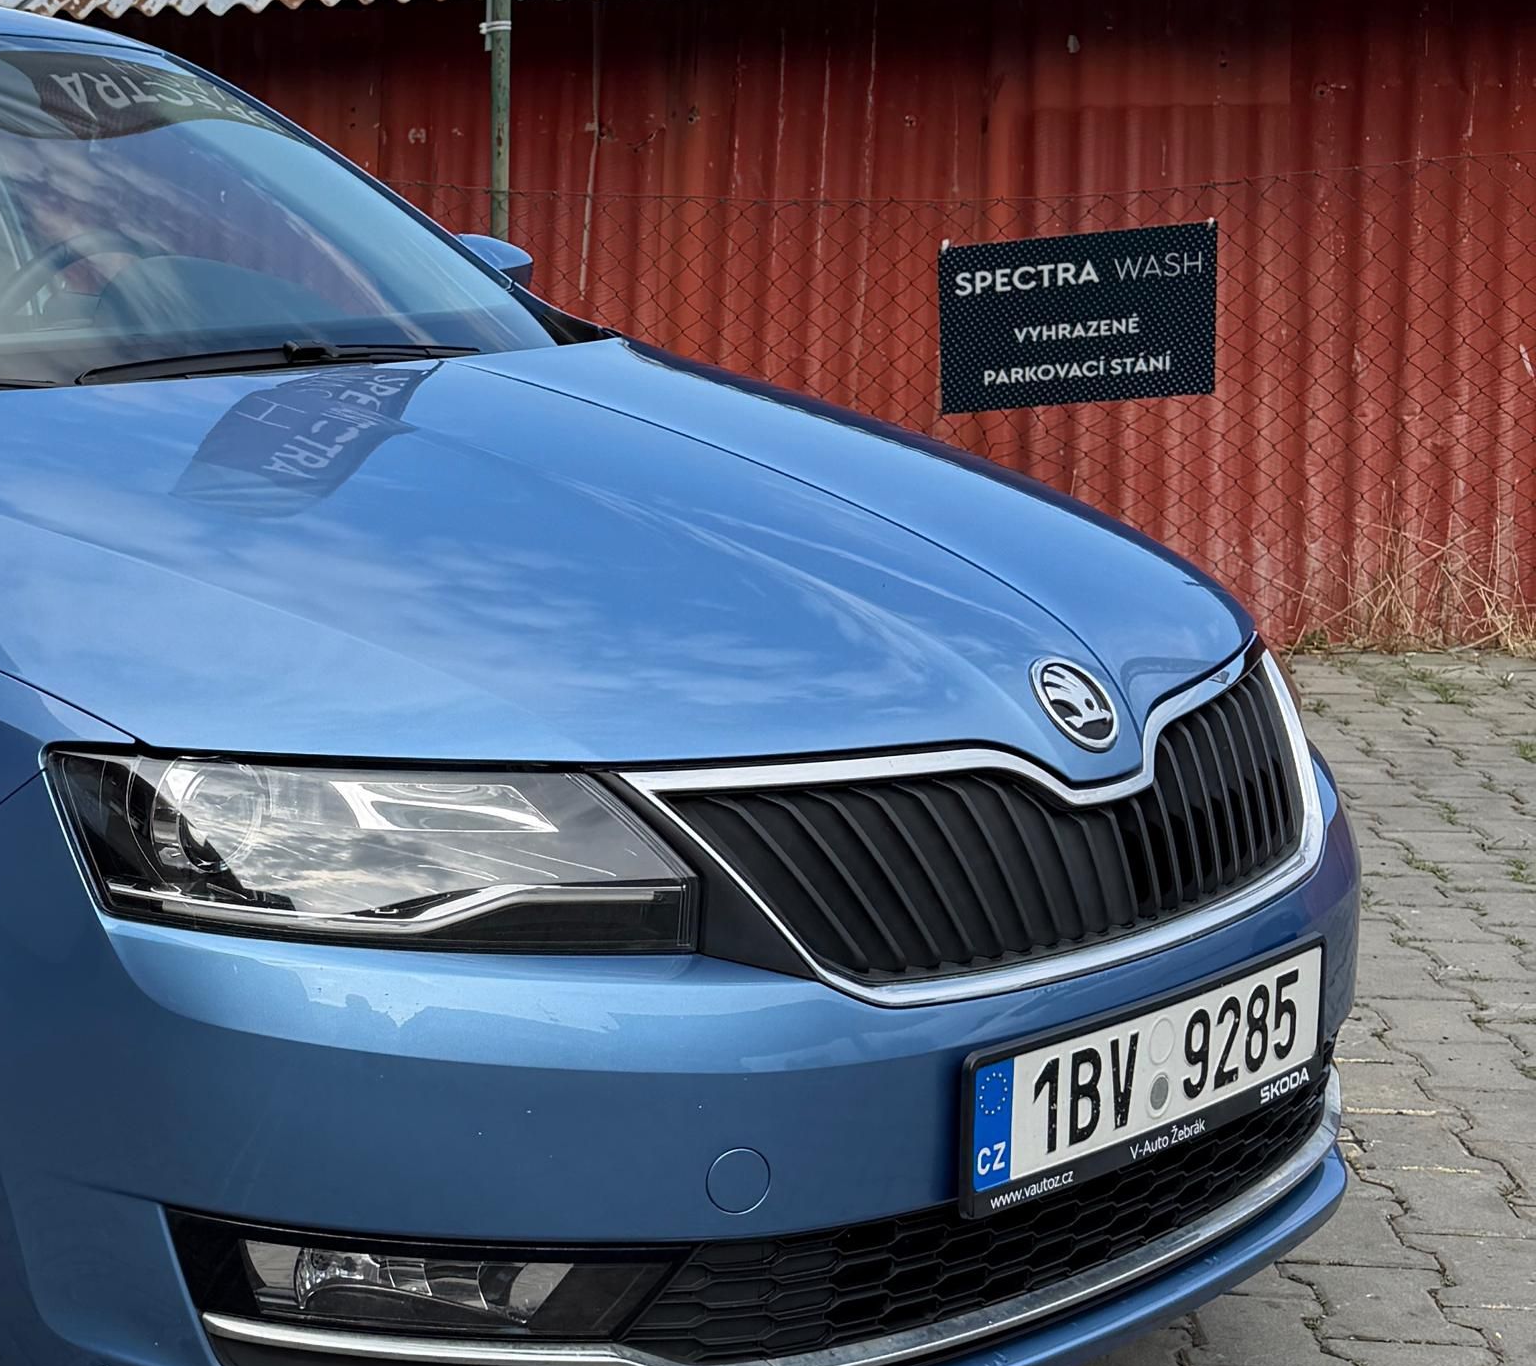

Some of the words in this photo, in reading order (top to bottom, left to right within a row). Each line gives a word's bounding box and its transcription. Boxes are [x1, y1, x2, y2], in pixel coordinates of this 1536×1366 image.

[954, 259, 1100, 297] SPECTRA
[1113, 250, 1203, 282] WASH
[1014, 313, 1140, 343] VYHRAZENÉ
[983, 355, 1106, 386] PARKOVACÍ
[1109, 350, 1172, 375] STÁNÍ
[1032, 1031, 1140, 1155] 1BV
[1182, 968, 1300, 1100] 9285
[976, 1141, 1007, 1176] CZ
[1129, 1133, 1170, 1160] V-Auto
[1170, 1117, 1206, 1146] Žebrák
[989, 1169, 1075, 1211] www.vautoz.cz
